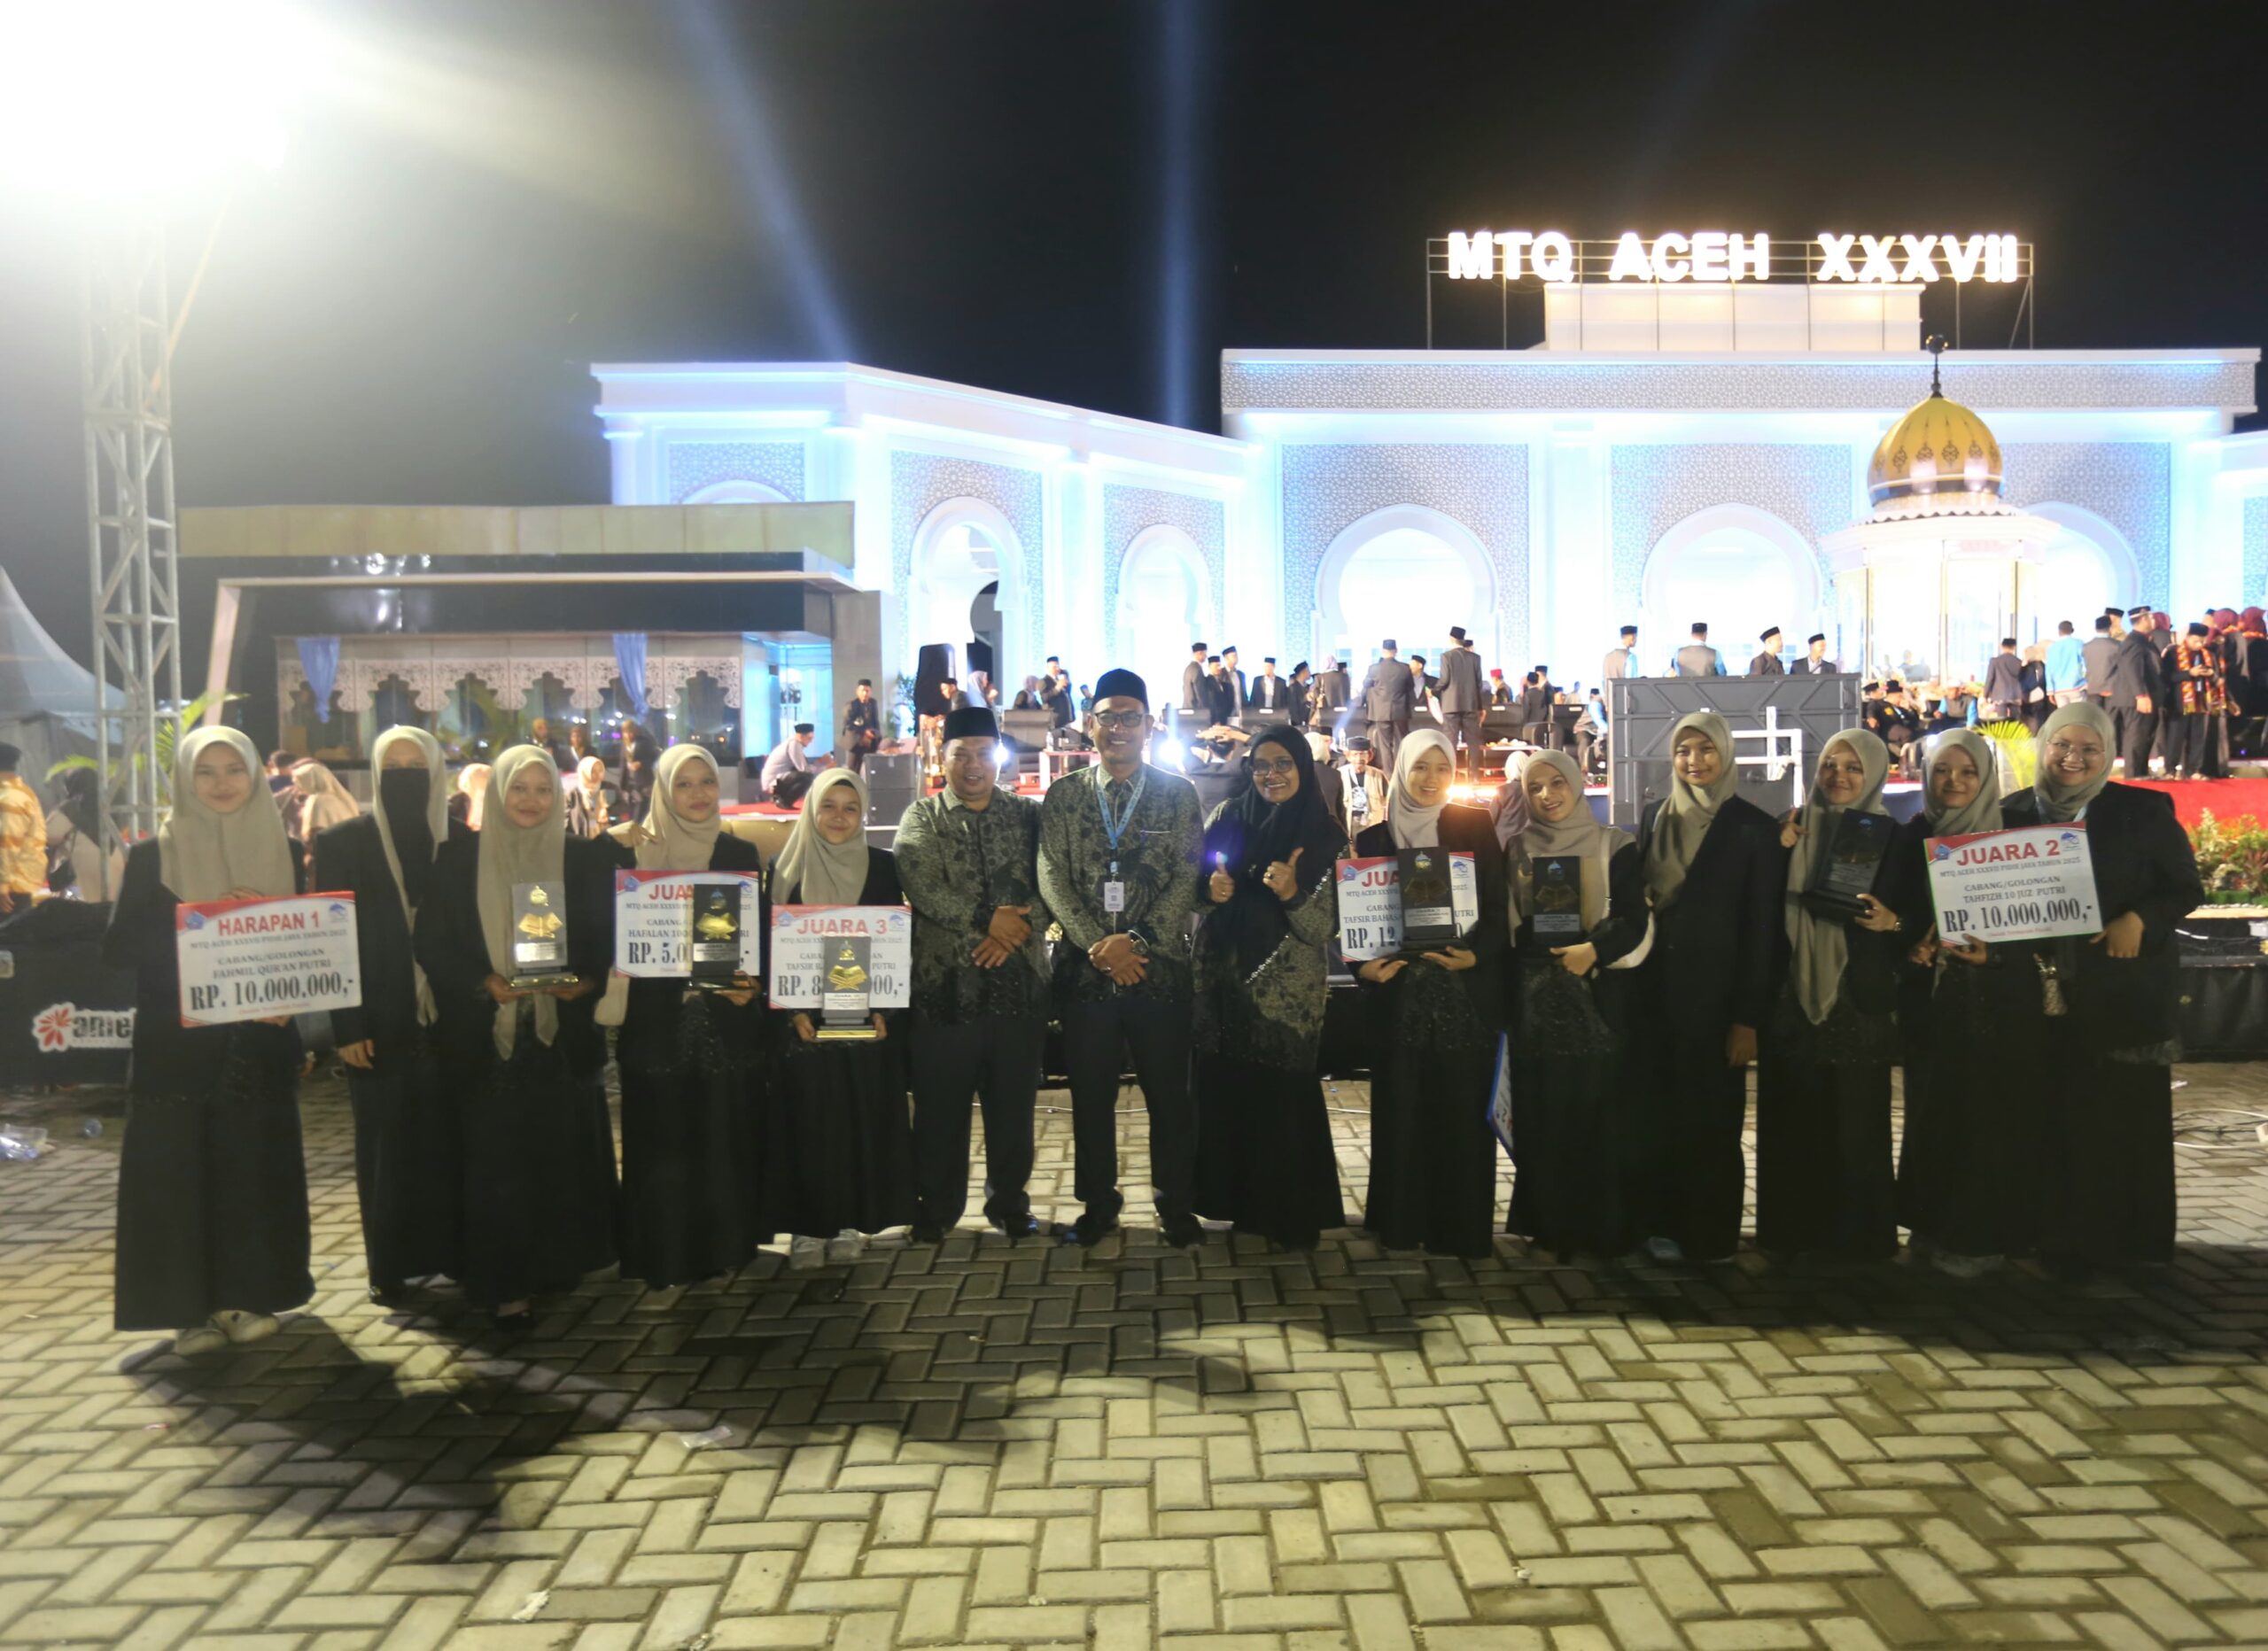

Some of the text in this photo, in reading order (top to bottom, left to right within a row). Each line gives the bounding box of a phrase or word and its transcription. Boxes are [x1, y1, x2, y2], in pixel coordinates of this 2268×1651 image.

[1449, 231, 2018, 283] MTQ ACEH XXXVII
[1957, 840, 2061, 866] JUARA 2
[1362, 871, 1400, 887] JUA
[649, 885, 694, 901] JUA
[2037, 886, 2066, 895] PUTRI
[1372, 913, 1401, 922] BAHAS
[1454, 909, 1474, 918] UTRI
[1944, 910, 1976, 933] RP.
[218, 911, 321, 937] HARAPAN 1
[797, 919, 888, 934] JUARA 3
[1347, 927, 1373, 949] RP.
[629, 942, 656, 964] RP.
[299, 958, 332, 970] PUTRI
[872, 962, 896, 971] PUTRI
[778, 974, 806, 996] RP.
[190, 985, 227, 1012] RP.
